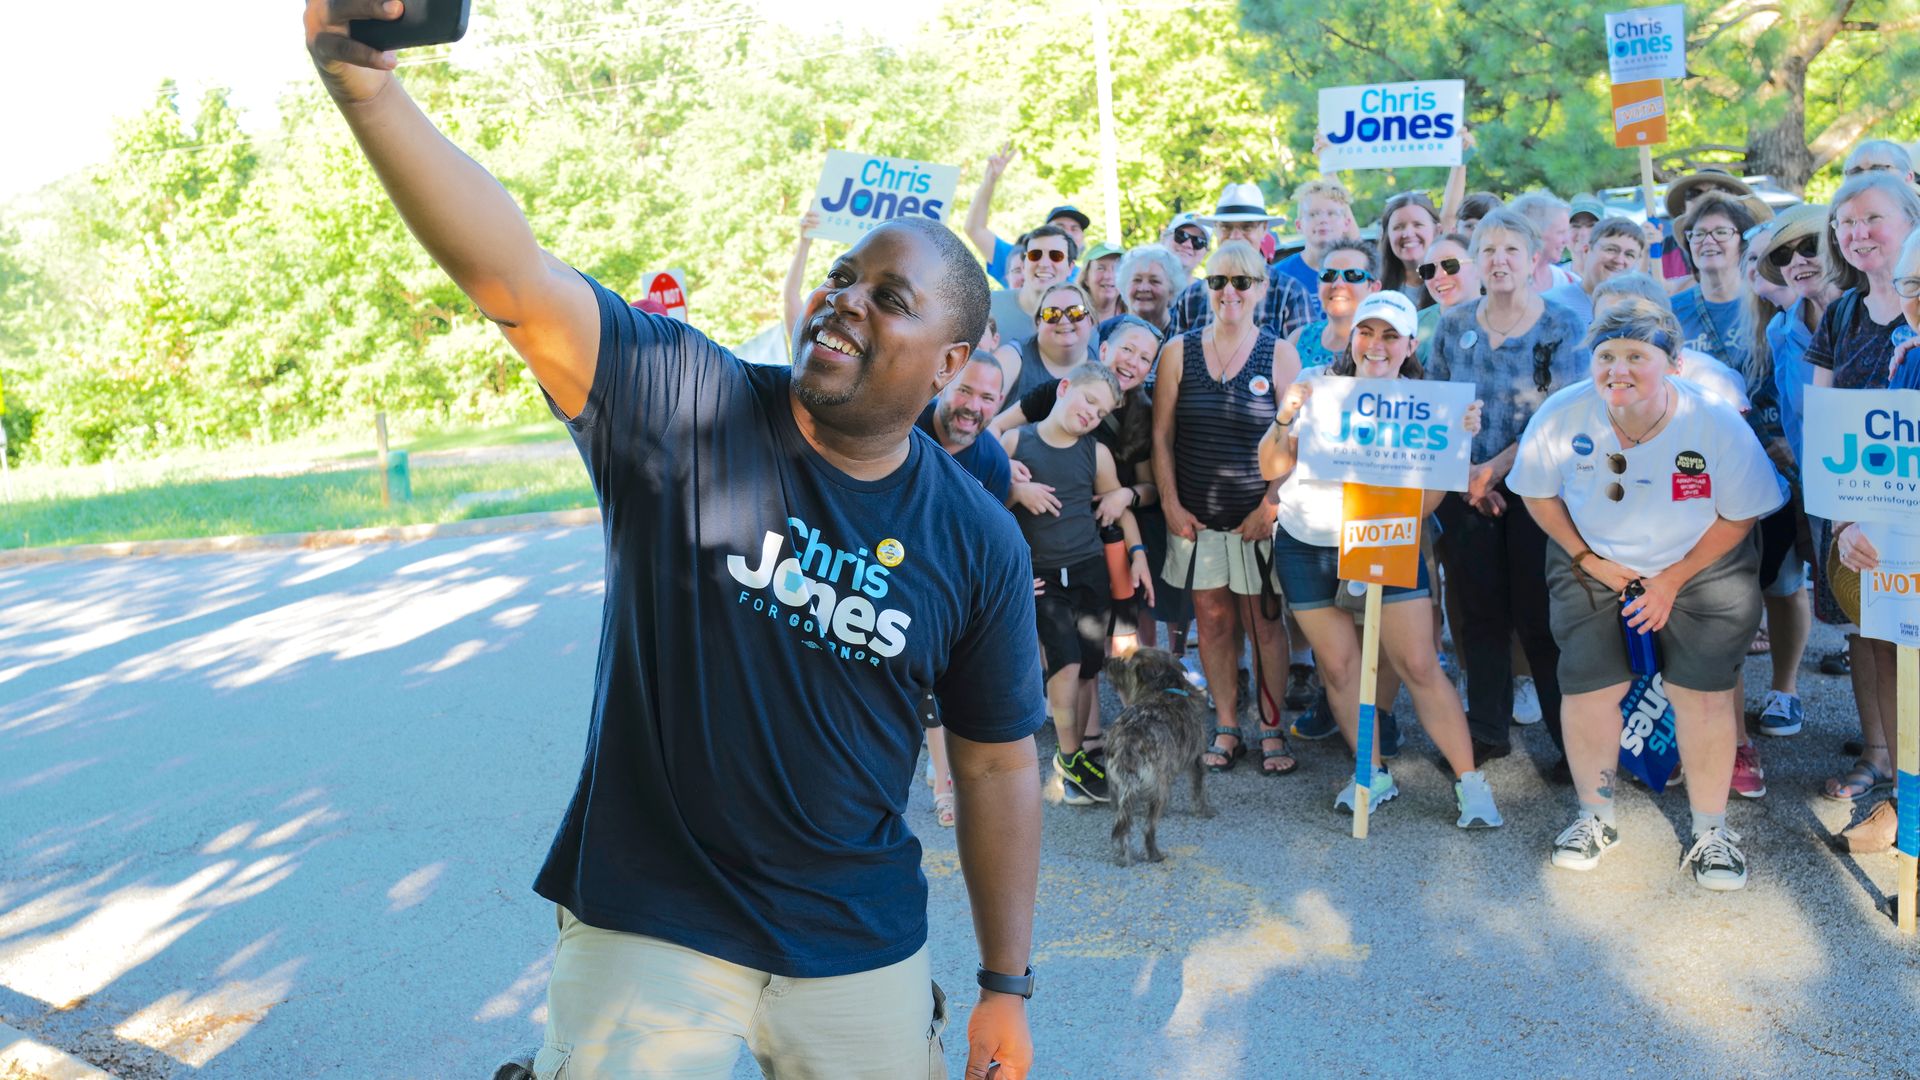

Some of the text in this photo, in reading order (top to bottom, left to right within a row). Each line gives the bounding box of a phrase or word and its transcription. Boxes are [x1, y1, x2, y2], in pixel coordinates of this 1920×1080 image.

[1615, 18, 1662, 39] Chris
[1361, 86, 1436, 114] Chris
[1327, 110, 1454, 144] Jones
[1371, 143, 1444, 153] GOVERNOR
[861, 159, 931, 194] Chris
[821, 177, 944, 221] Jones
[1357, 392, 1431, 421] Chris
[1322, 411, 1448, 451] Jones
[1366, 449, 1436, 461] GOVERNOR
[1679, 456, 1704, 464] WOMEN
[1837, 478, 1871, 489] FOR
[1349, 522, 1412, 543] ¡VOTA!
[727, 530, 912, 658] Jones
[739, 591, 778, 619] FOR
